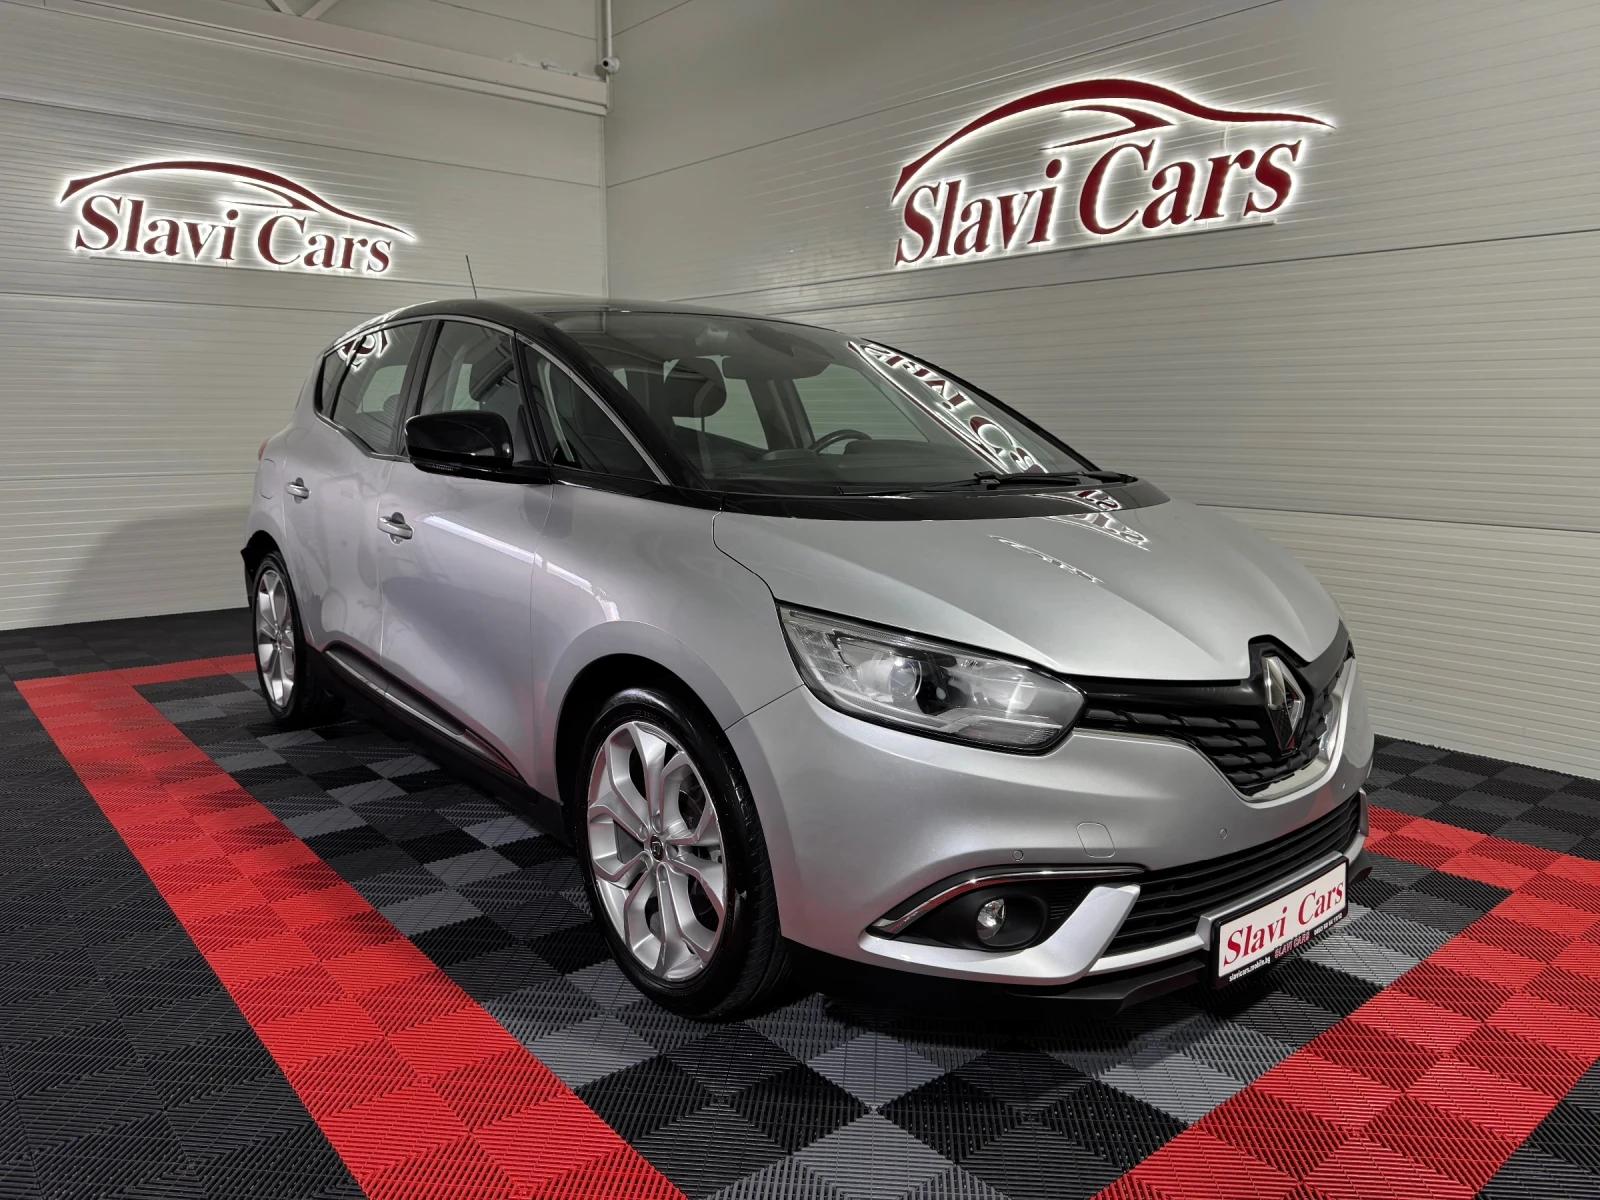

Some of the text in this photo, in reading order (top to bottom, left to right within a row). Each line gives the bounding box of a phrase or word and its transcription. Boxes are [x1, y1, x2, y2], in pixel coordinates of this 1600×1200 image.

[75, 195, 393, 273] Slavi Cars
[895, 139, 1303, 266] Slavi Cars
[1223, 906, 1288, 967] Slavi
[1297, 882, 1344, 926] Cars
[1274, 930, 1311, 959] SLAVI CARS
